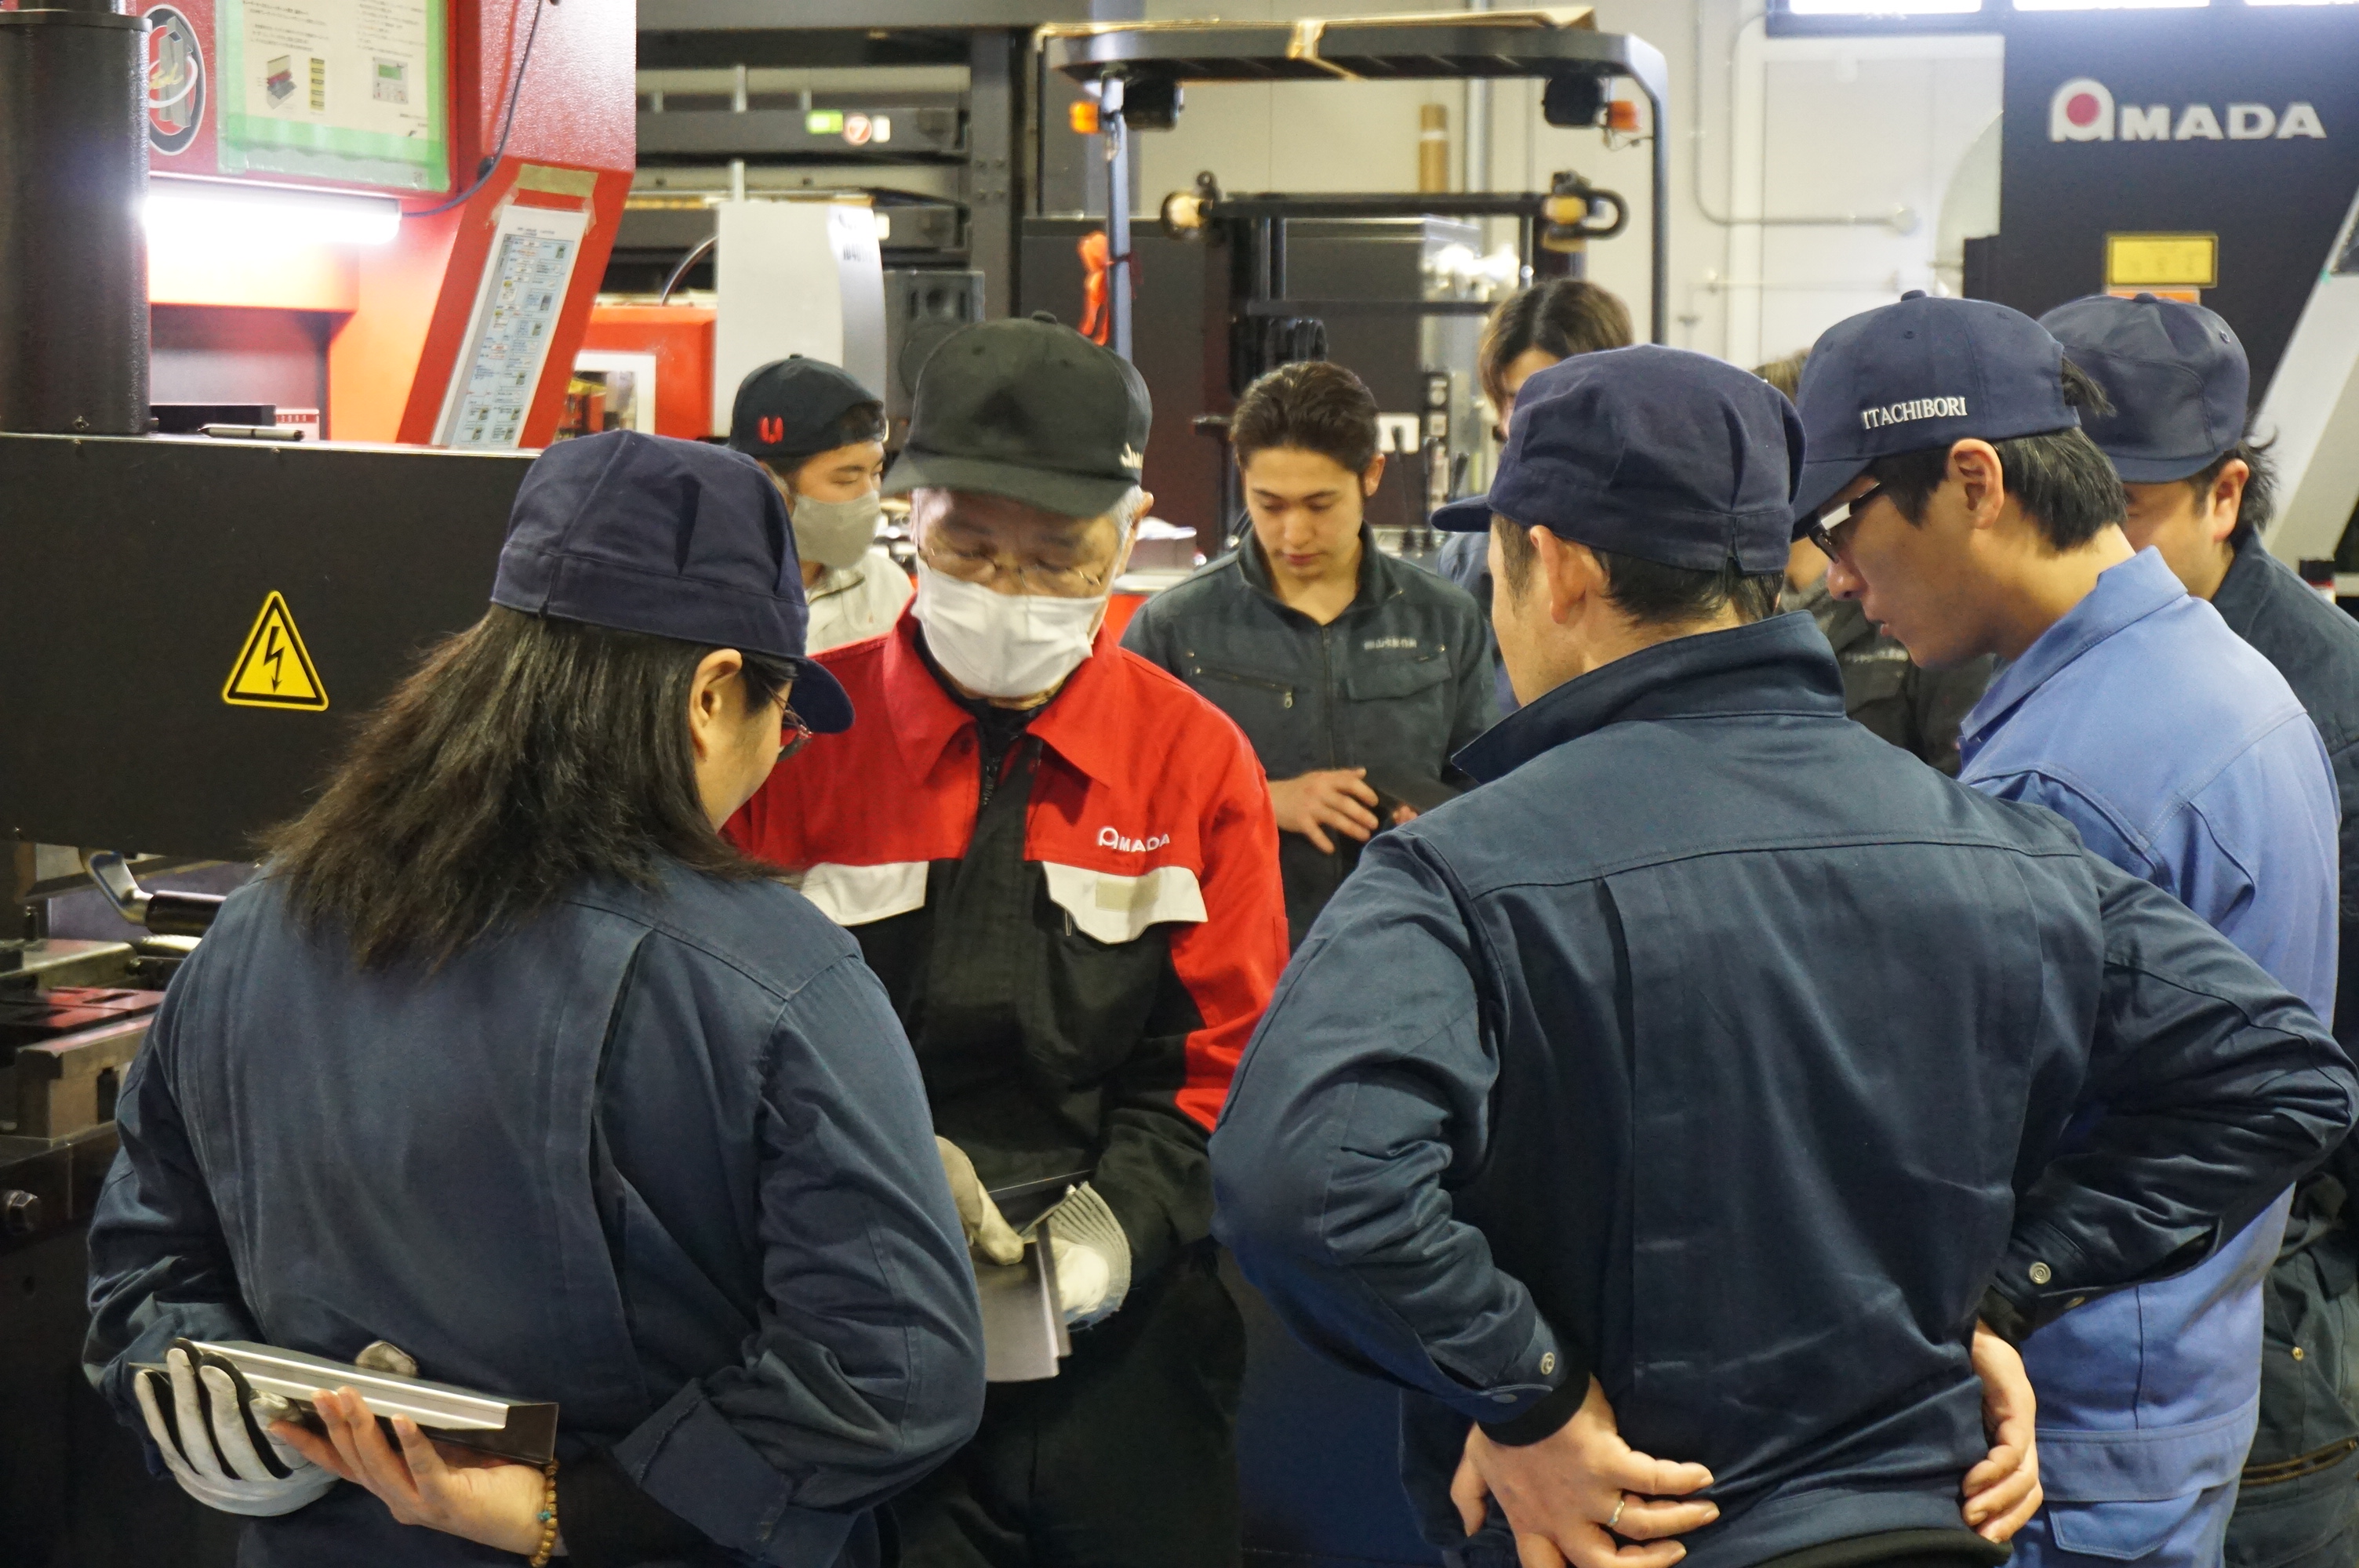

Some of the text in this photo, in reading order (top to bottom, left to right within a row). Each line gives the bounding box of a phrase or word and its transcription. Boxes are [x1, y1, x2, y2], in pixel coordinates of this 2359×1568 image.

[2051, 78, 2328, 142] AMADA
[1863, 396, 1968, 430] ITACHIBORI
[1099, 827, 1170, 852] AMADA
